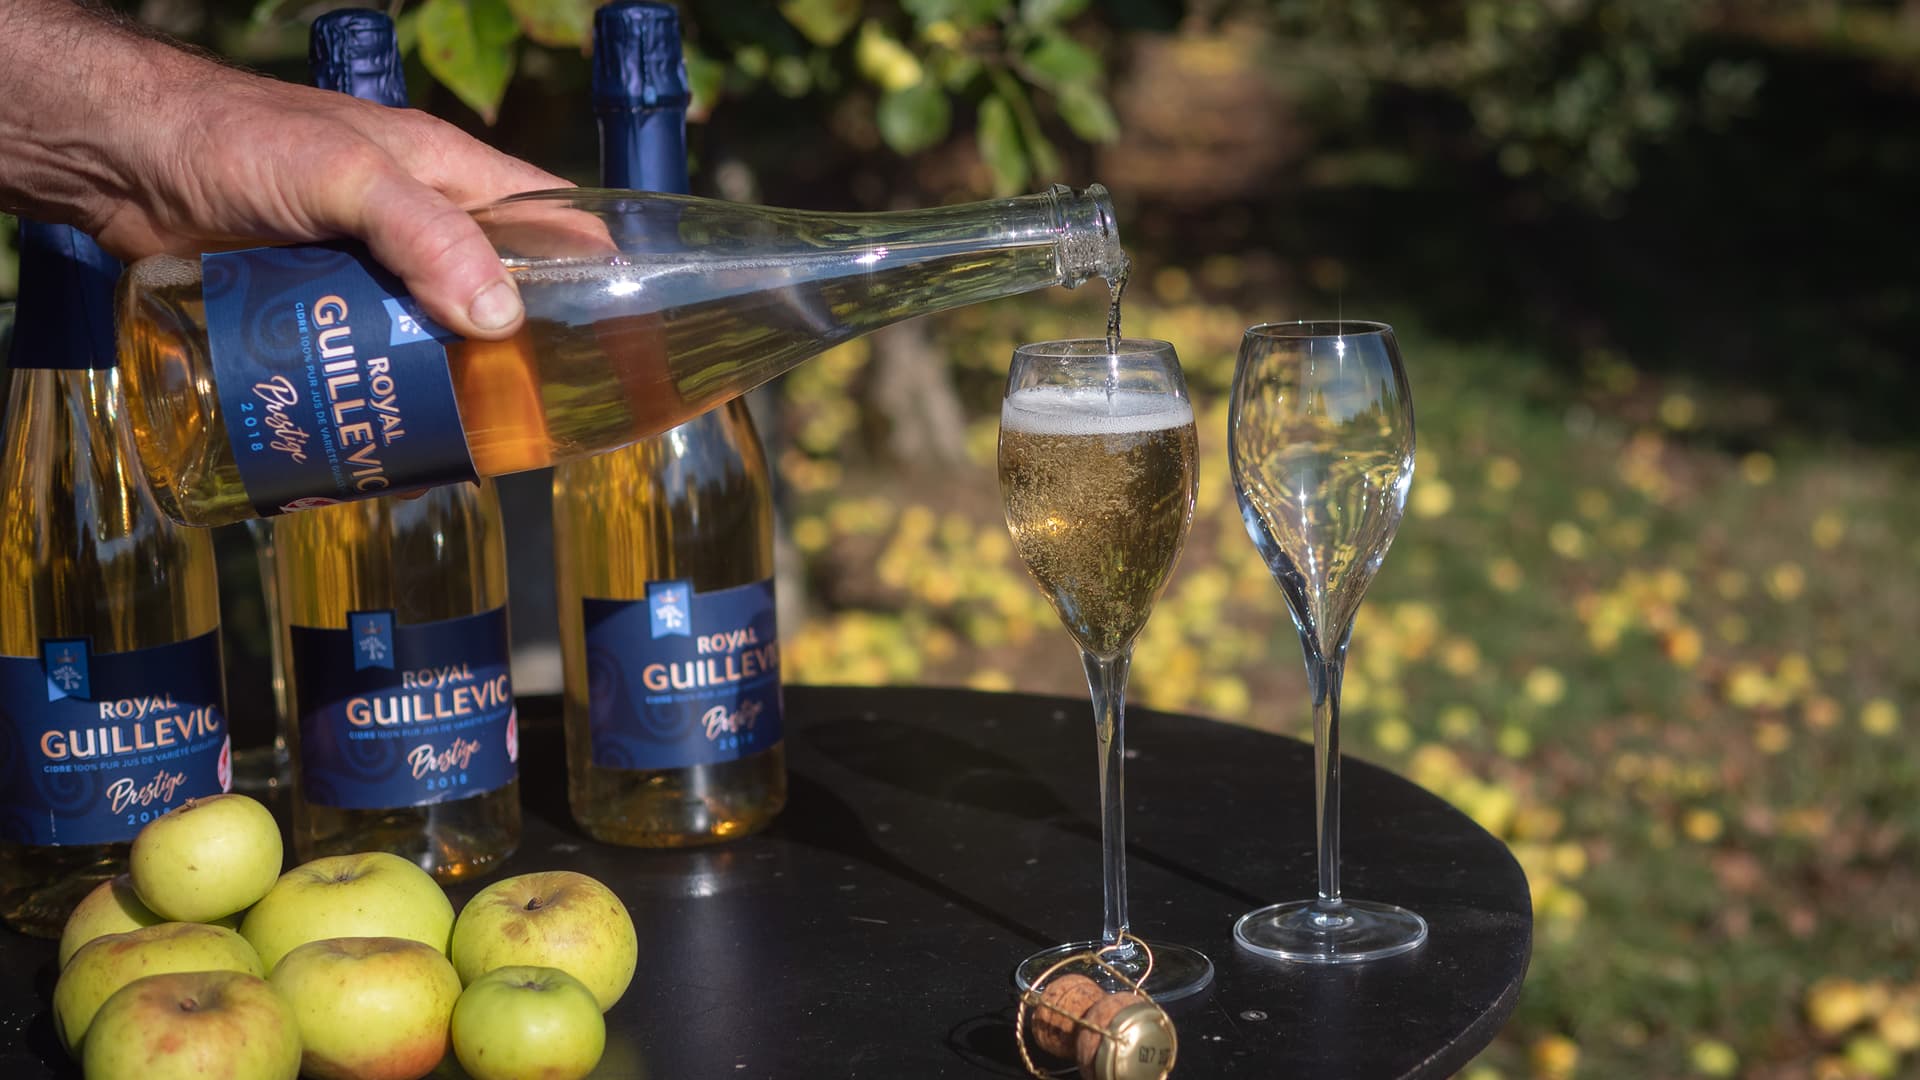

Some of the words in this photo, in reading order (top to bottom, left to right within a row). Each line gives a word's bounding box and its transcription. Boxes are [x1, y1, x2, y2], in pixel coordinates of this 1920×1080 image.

[295, 302, 308, 334] CIDRE
[301, 335, 312, 362] 100%
[306, 365, 318, 387] PUR
[311, 389, 323, 409] JUS
[312, 295, 390, 491] GUILLEVIC
[368, 356, 406, 446] ROYAL
[241, 402, 264, 451] 2018
[252, 375, 310, 464] Prestige
[316, 411, 327, 425] DE
[697, 628, 758, 654] ROYAL
[402, 663, 473, 689] ROYAL
[643, 643, 777, 691] GUILLEVI
[99, 692, 177, 720] ROYAL
[346, 674, 509, 726] GUILLEVIC
[40, 704, 219, 758] GUILLEVIC
[43, 764, 72, 773] CIDRE
[100, 760, 119, 769] PUR
[122, 757, 139, 767] JUS
[142, 755, 153, 765] DE
[407, 738, 480, 780] Prestige
[106, 769, 187, 815] Prestige
[426, 773, 468, 790] 2018
